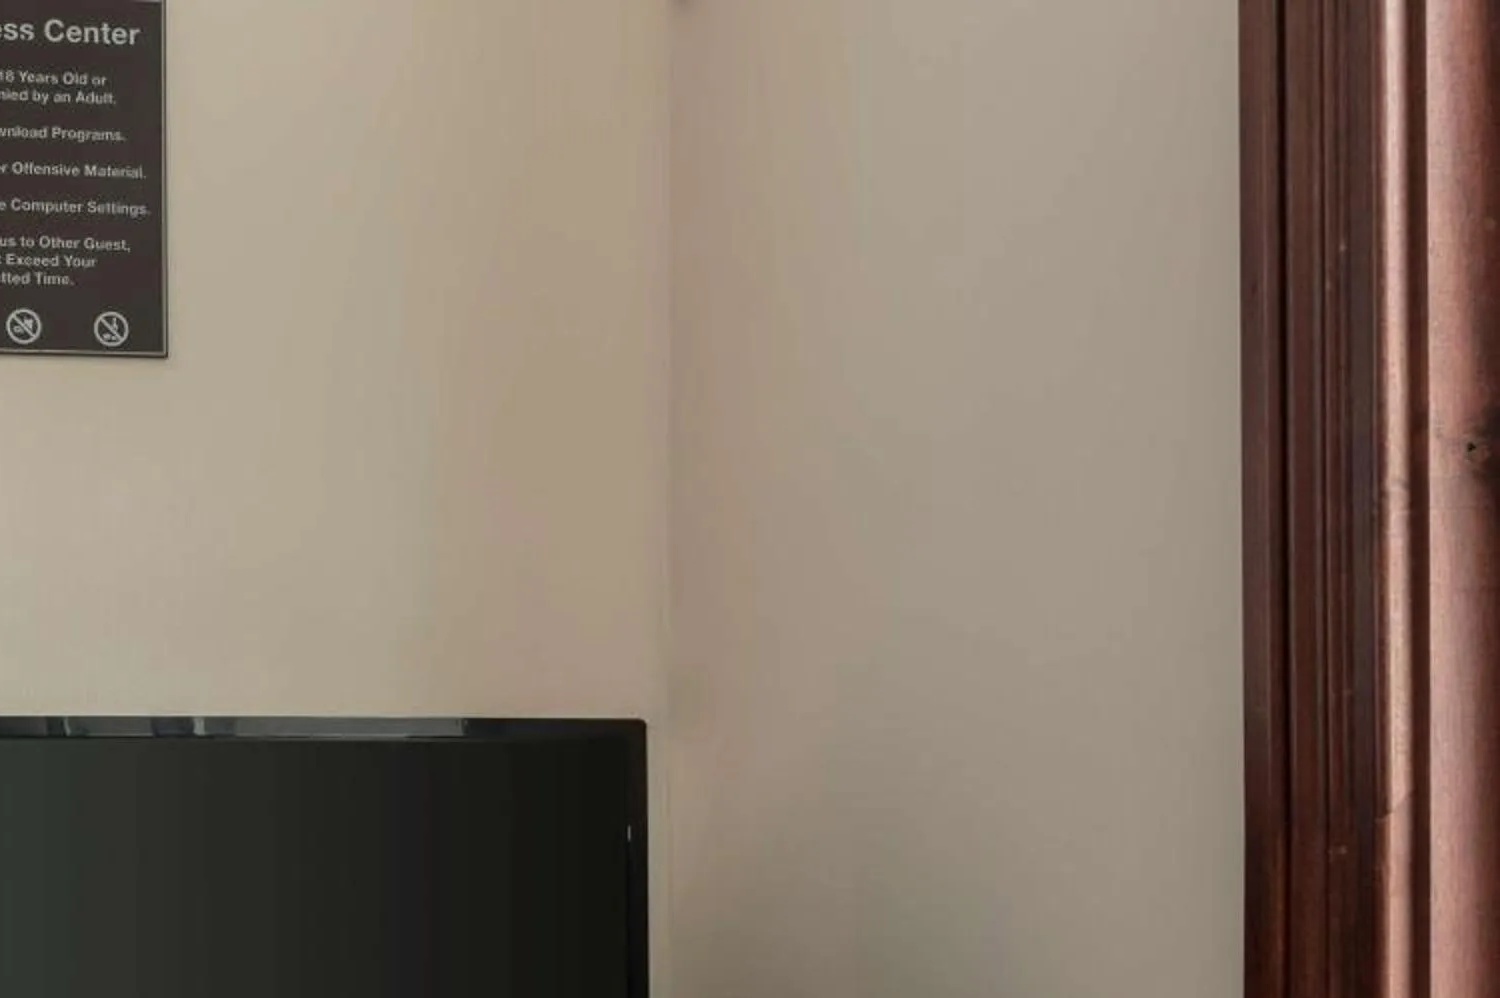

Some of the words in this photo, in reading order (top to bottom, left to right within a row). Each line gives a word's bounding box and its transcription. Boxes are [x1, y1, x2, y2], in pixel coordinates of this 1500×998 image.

[43, 18, 141, 45] Center
[19, 70, 59, 85] Years
[62, 71, 88, 86] Old
[91, 75, 107, 86] or
[32, 89, 49, 105] by
[53, 92, 71, 103] an
[75, 91, 116, 105] Adult.
[51, 126, 126, 143] Programs.
[11, 161, 80, 177] Offensive
[84, 164, 147, 179] Material.
[10, 197, 83, 214] Computer
[20, 236, 35, 248] to
[39, 236, 80, 249] Other
[5, 253, 60, 267] Exceed
[63, 255, 98, 268] Your
